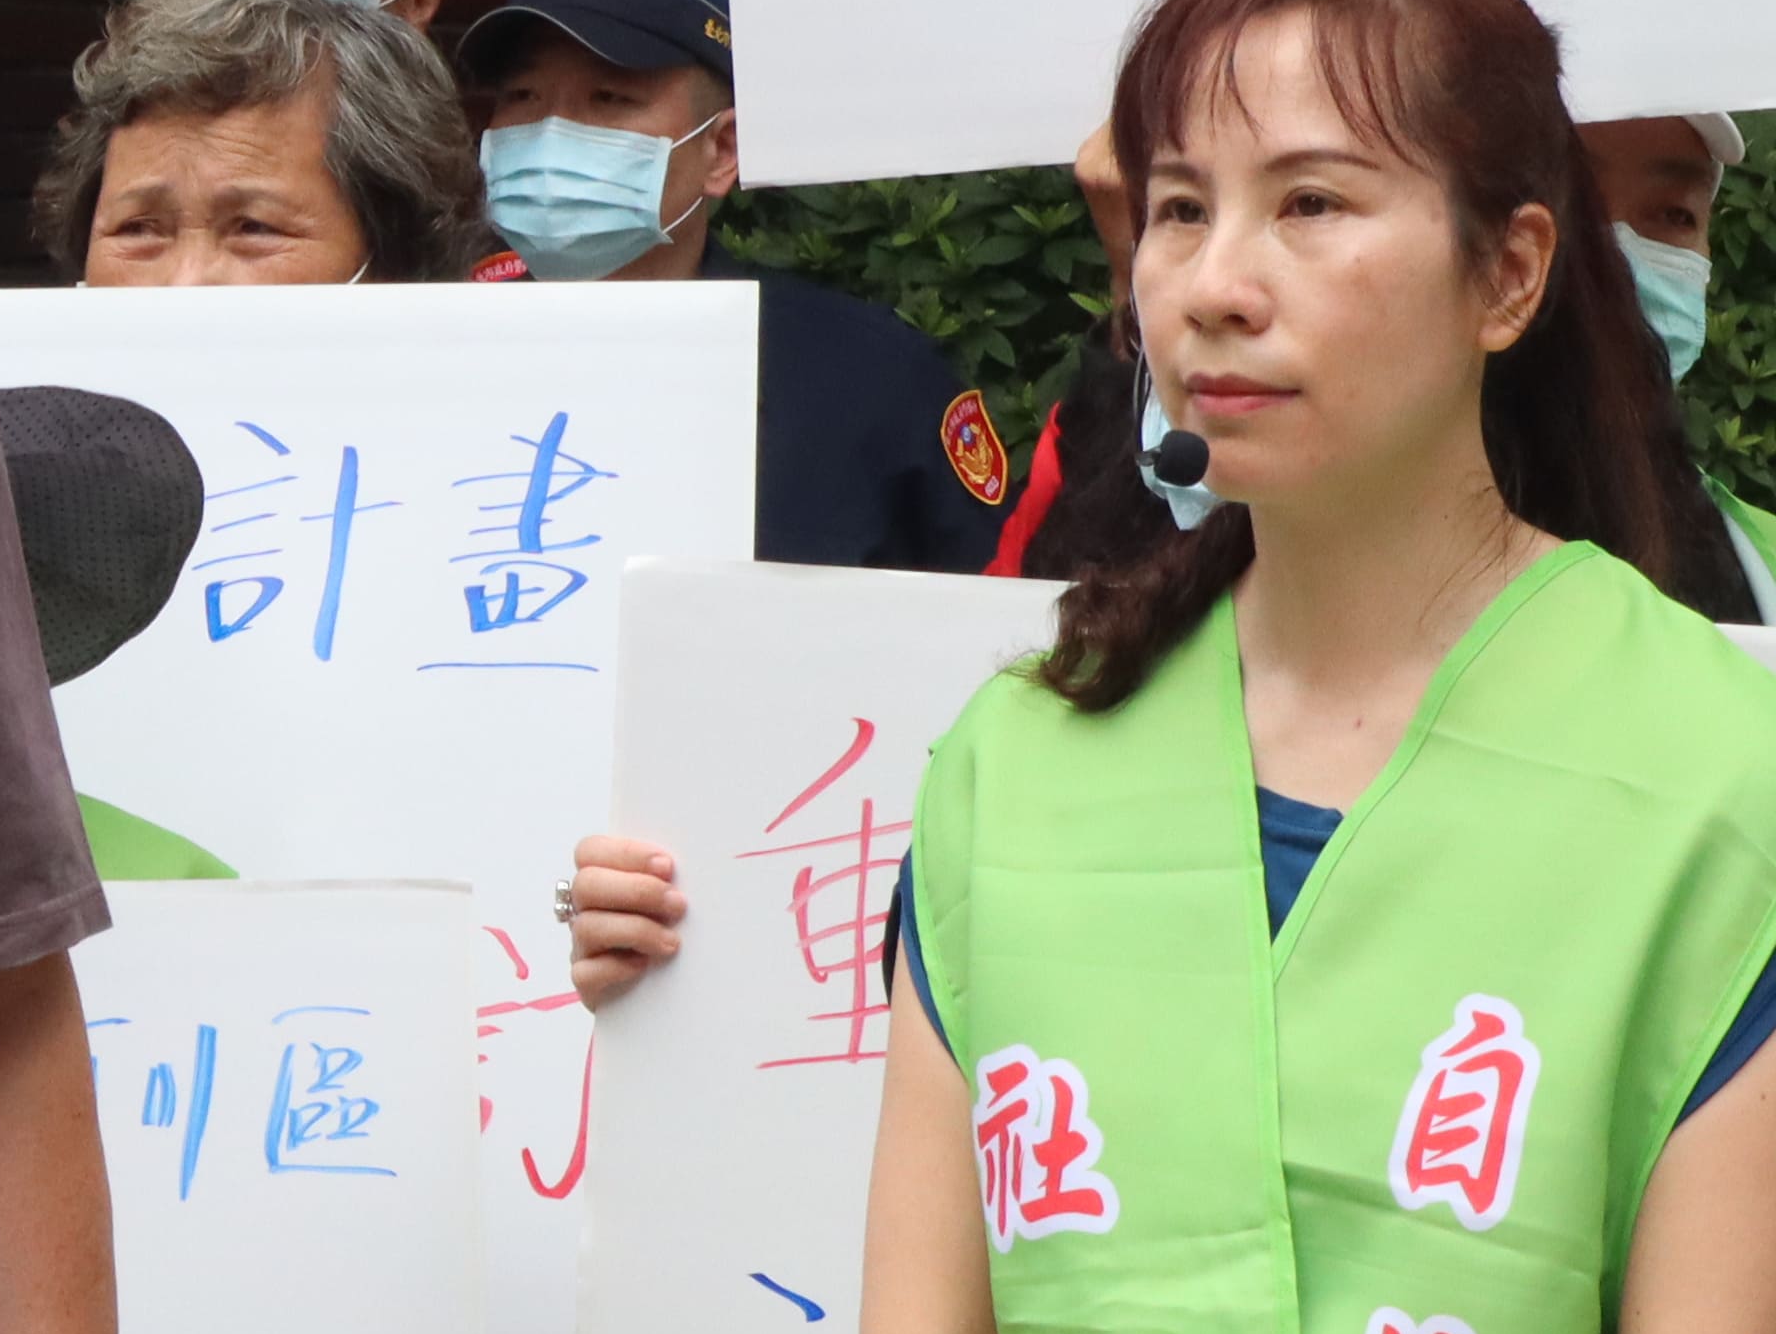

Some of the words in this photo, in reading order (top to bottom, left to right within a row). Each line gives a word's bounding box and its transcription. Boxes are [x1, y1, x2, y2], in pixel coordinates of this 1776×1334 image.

[192, 409, 619, 673] 計畫
[733, 716, 913, 1069] 重
[86, 1005, 398, 1202] 川區
